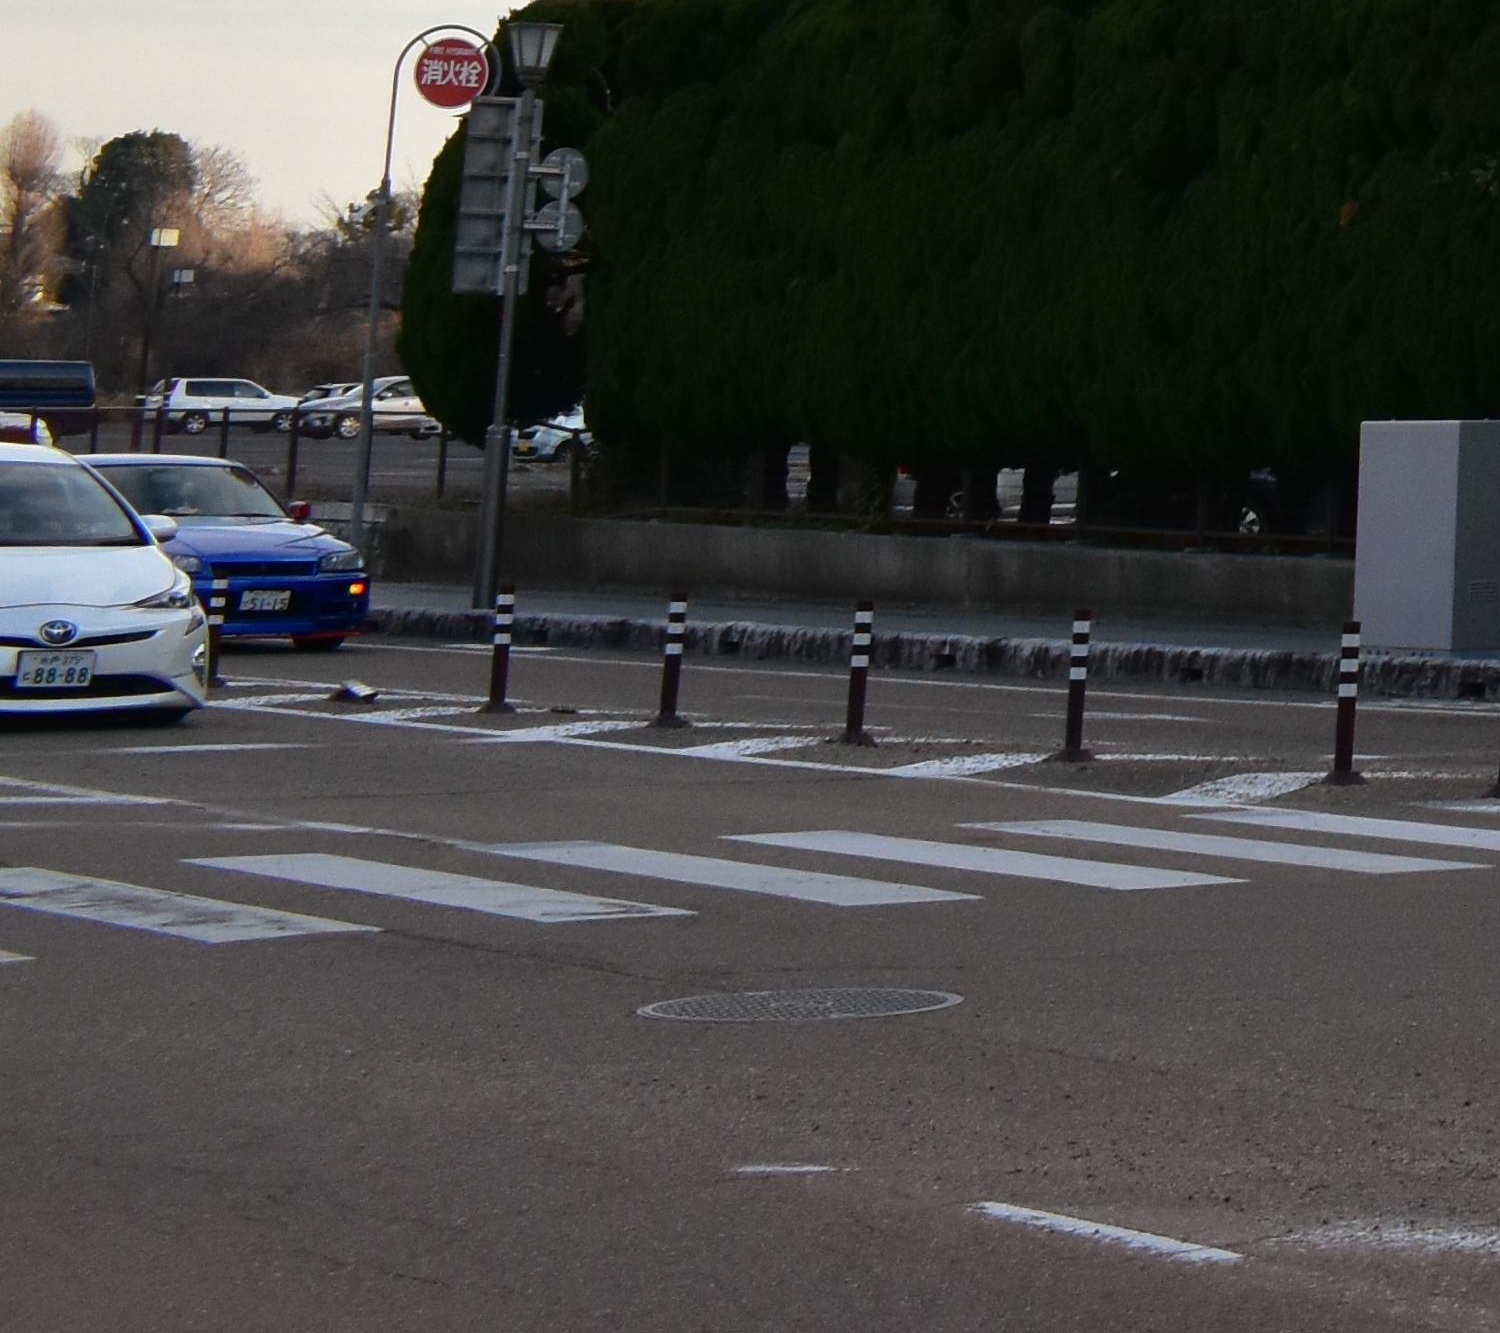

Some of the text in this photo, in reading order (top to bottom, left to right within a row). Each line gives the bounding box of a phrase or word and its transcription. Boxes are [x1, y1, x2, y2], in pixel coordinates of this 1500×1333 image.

[421, 59, 482, 87] 消火栓
[33, 667, 89, 684] 88-88
